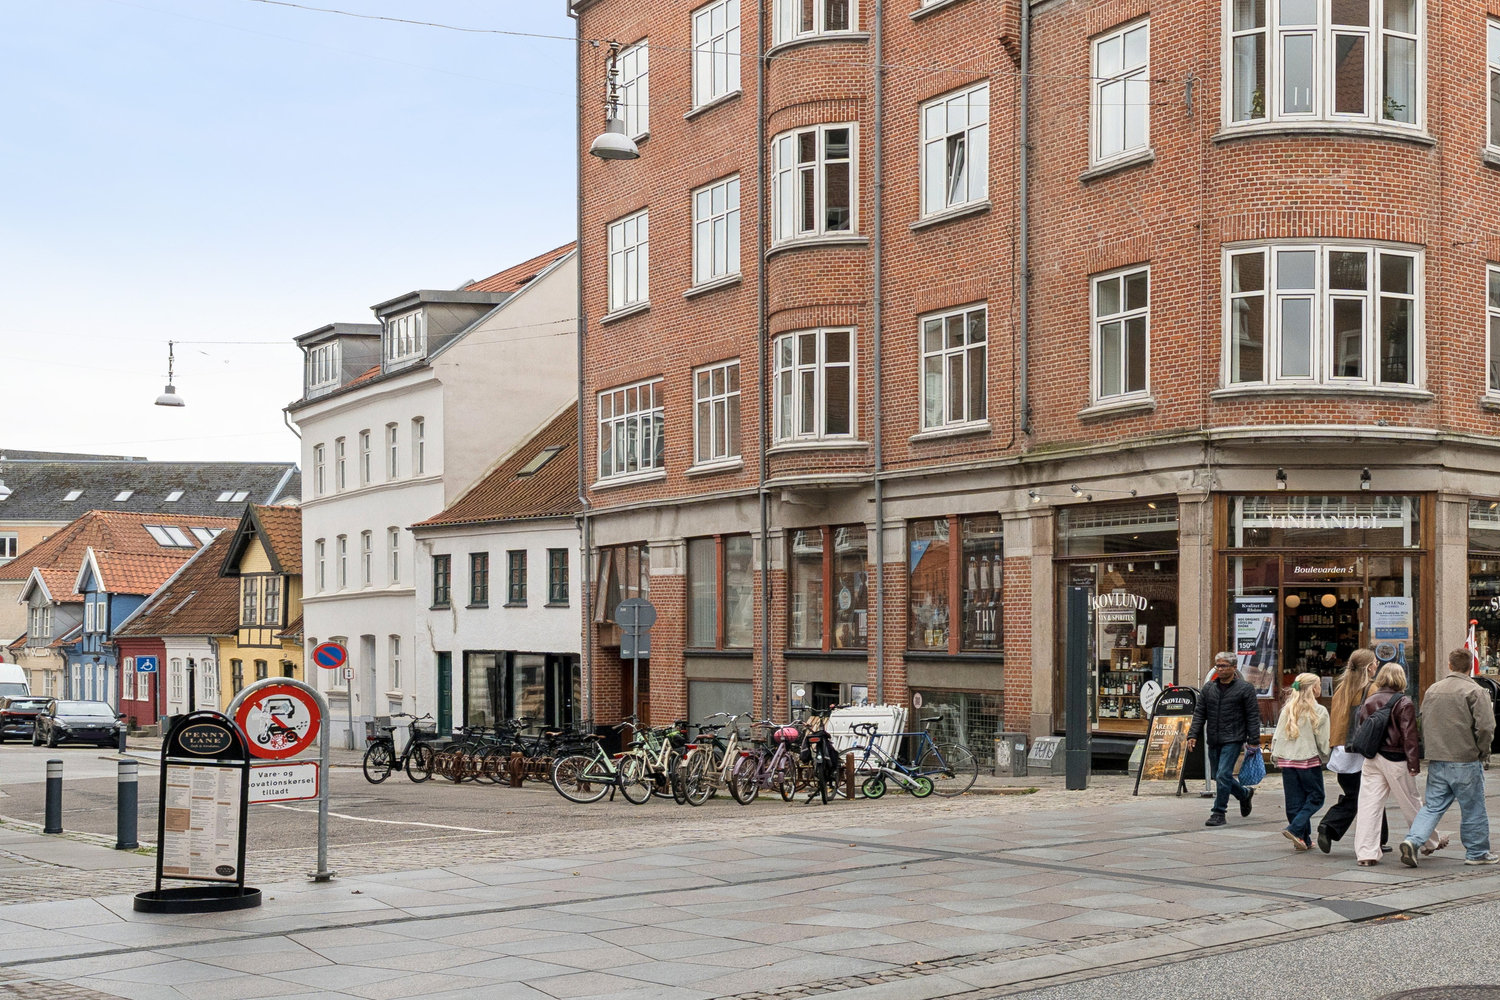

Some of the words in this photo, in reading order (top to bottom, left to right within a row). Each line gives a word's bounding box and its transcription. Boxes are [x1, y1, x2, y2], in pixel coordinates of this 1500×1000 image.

[1266, 515, 1383, 529] VINHANDEL
[1294, 566, 1346, 574] Boulevarden
[1089, 592, 1148, 611] KOVLUND
[975, 610, 996, 631] THY
[283, 770, 293, 778] og
[249, 777, 314, 788] ovationskørsel
[262, 788, 289, 796] tilladt
